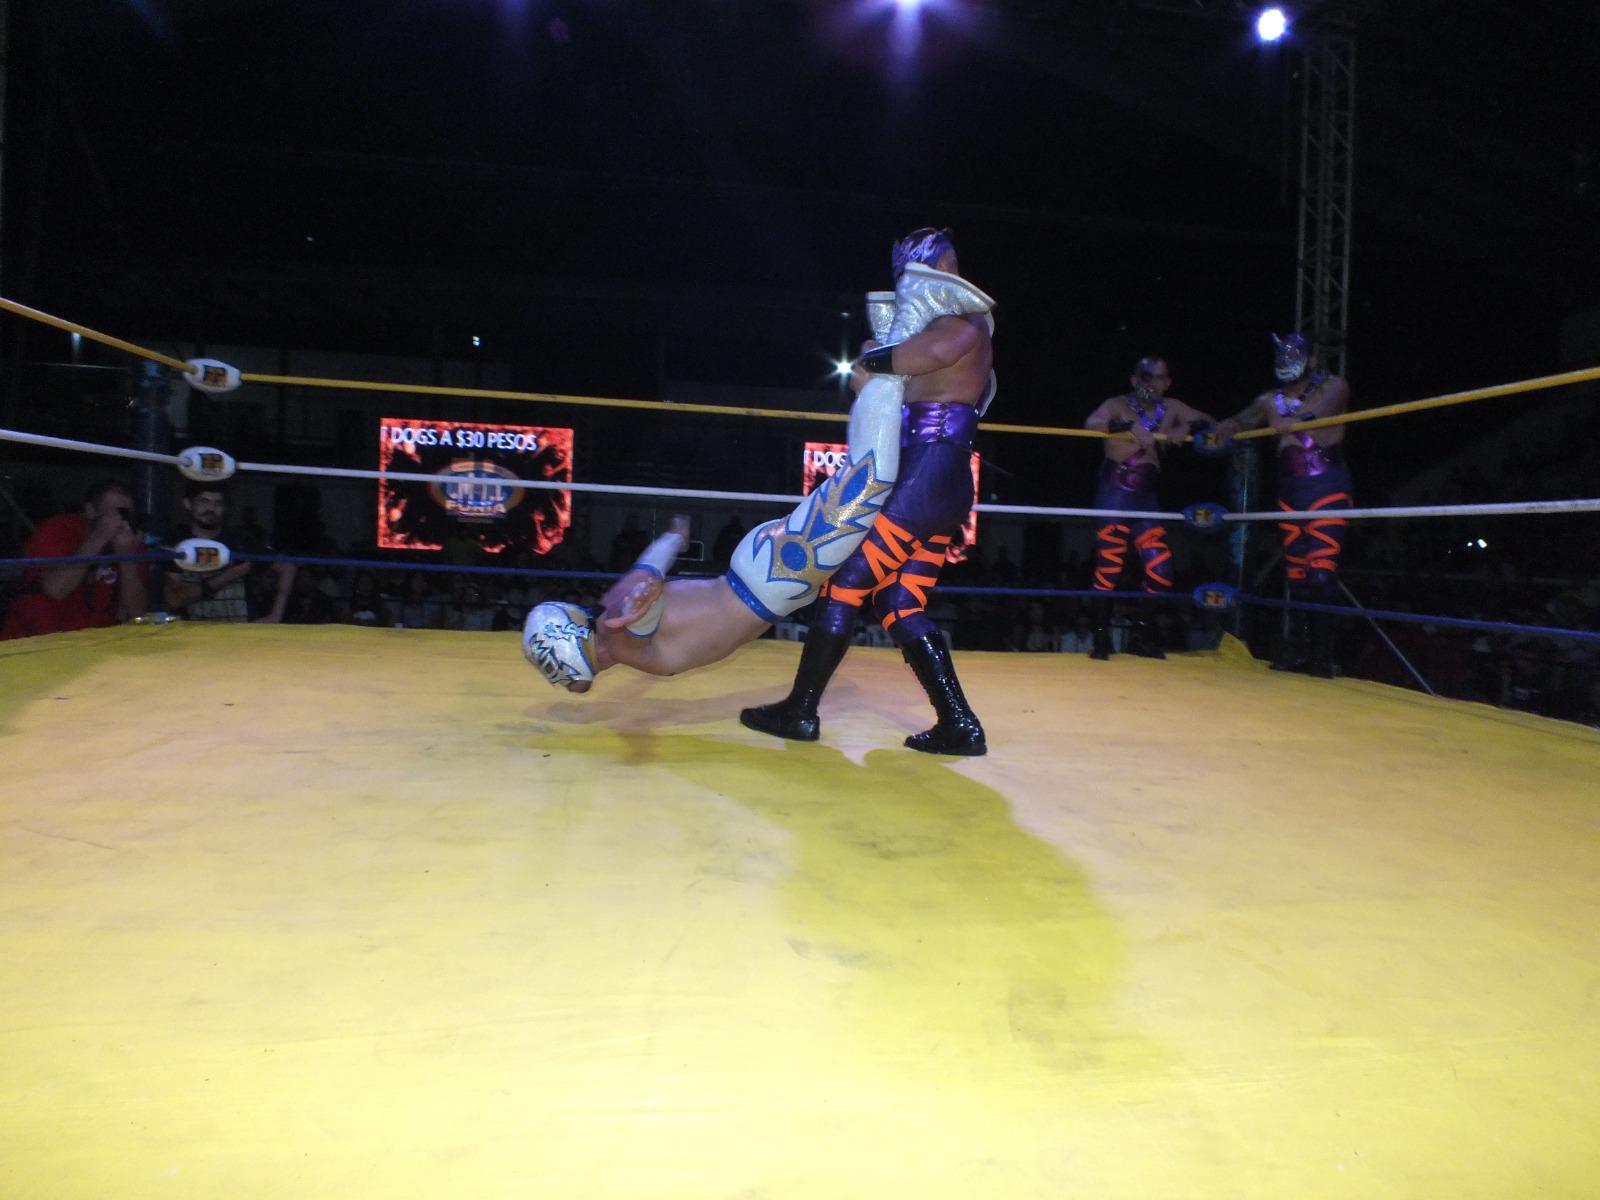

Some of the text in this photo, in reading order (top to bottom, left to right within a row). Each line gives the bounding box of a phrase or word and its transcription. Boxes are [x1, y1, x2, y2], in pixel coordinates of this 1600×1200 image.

[391, 427, 438, 445] DOGS
[440, 430, 453, 446] A
[456, 429, 485, 448] $30
[488, 432, 537, 451] PESOS
